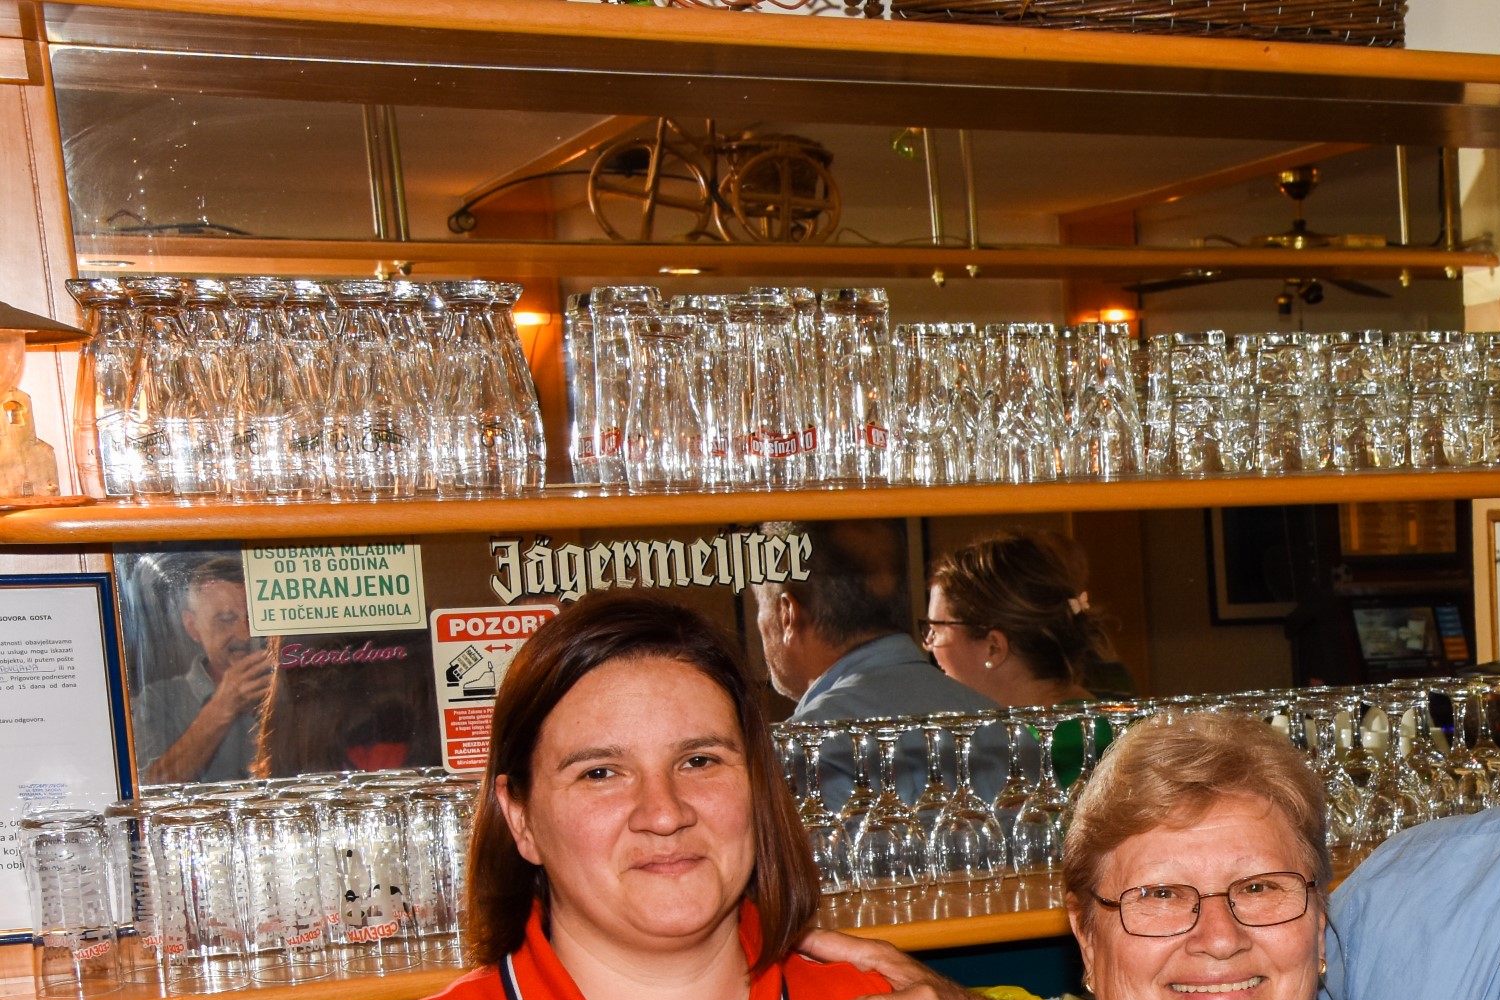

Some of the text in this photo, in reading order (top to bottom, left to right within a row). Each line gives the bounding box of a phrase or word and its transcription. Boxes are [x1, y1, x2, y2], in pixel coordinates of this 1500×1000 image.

[253, 542, 406, 560] OSOBAMA MLAĐIM
[274, 557, 389, 573] OD 18 GODINA
[490, 531, 812, 603] Jägermeister
[256, 574, 410, 601] ZABRANJENO
[261, 603, 412, 622] JE TOČENJE ALKOHOLA
[34, 656, 55, 664] putem
[14, 717, 46, 725] odgovora.
[286, 928, 321, 945] CEDEVITA
[347, 920, 399, 943] CEDEVITA
[73, 940, 111, 960] CEDEVITA
